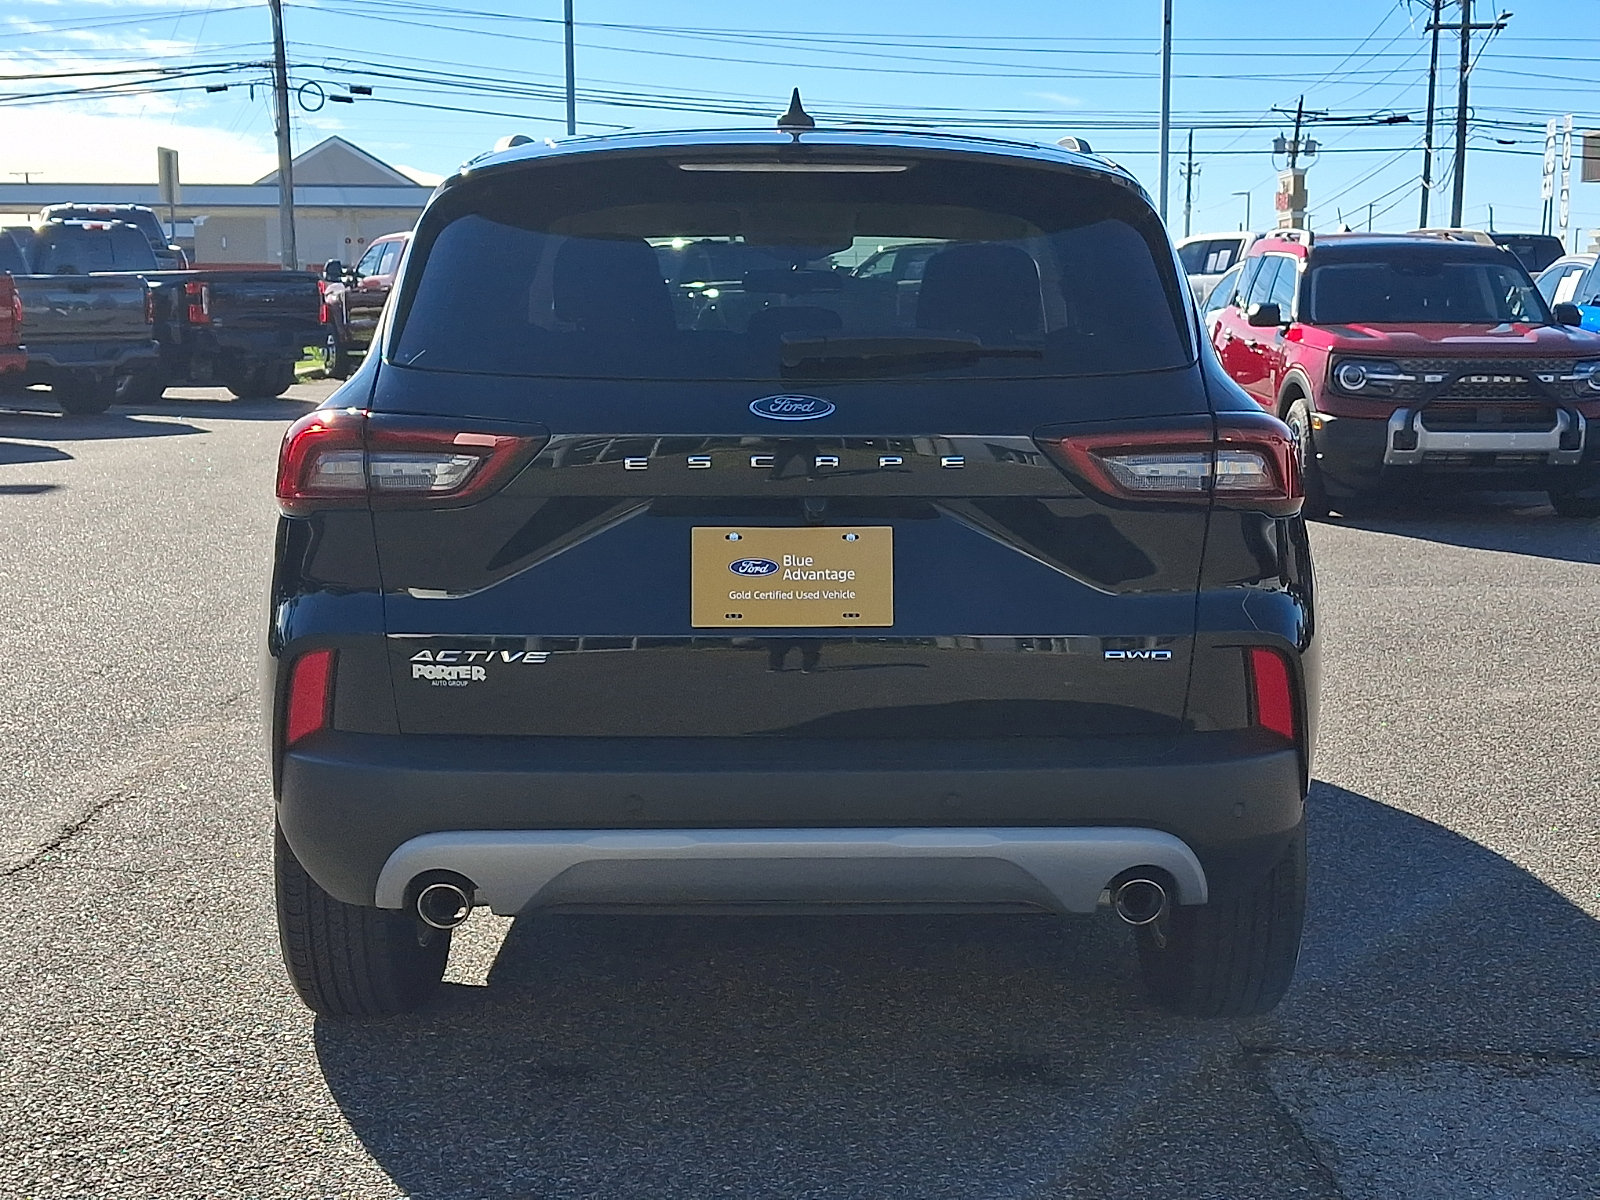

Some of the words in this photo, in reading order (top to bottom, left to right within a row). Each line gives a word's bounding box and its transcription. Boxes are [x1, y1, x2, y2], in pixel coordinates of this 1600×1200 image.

[769, 397, 815, 414] Ford
[623, 455, 965, 470] ESCAPE
[783, 554, 814, 567] Blue
[782, 568, 856, 583] Advantage
[729, 590, 751, 600] Gold
[754, 590, 793, 600] Certified
[795, 590, 820, 600] Used
[822, 590, 856, 600] Vehicle
[409, 649, 551, 664] ACTIVE
[1104, 650, 1172, 661] AWD
[412, 664, 487, 681] PORTER
